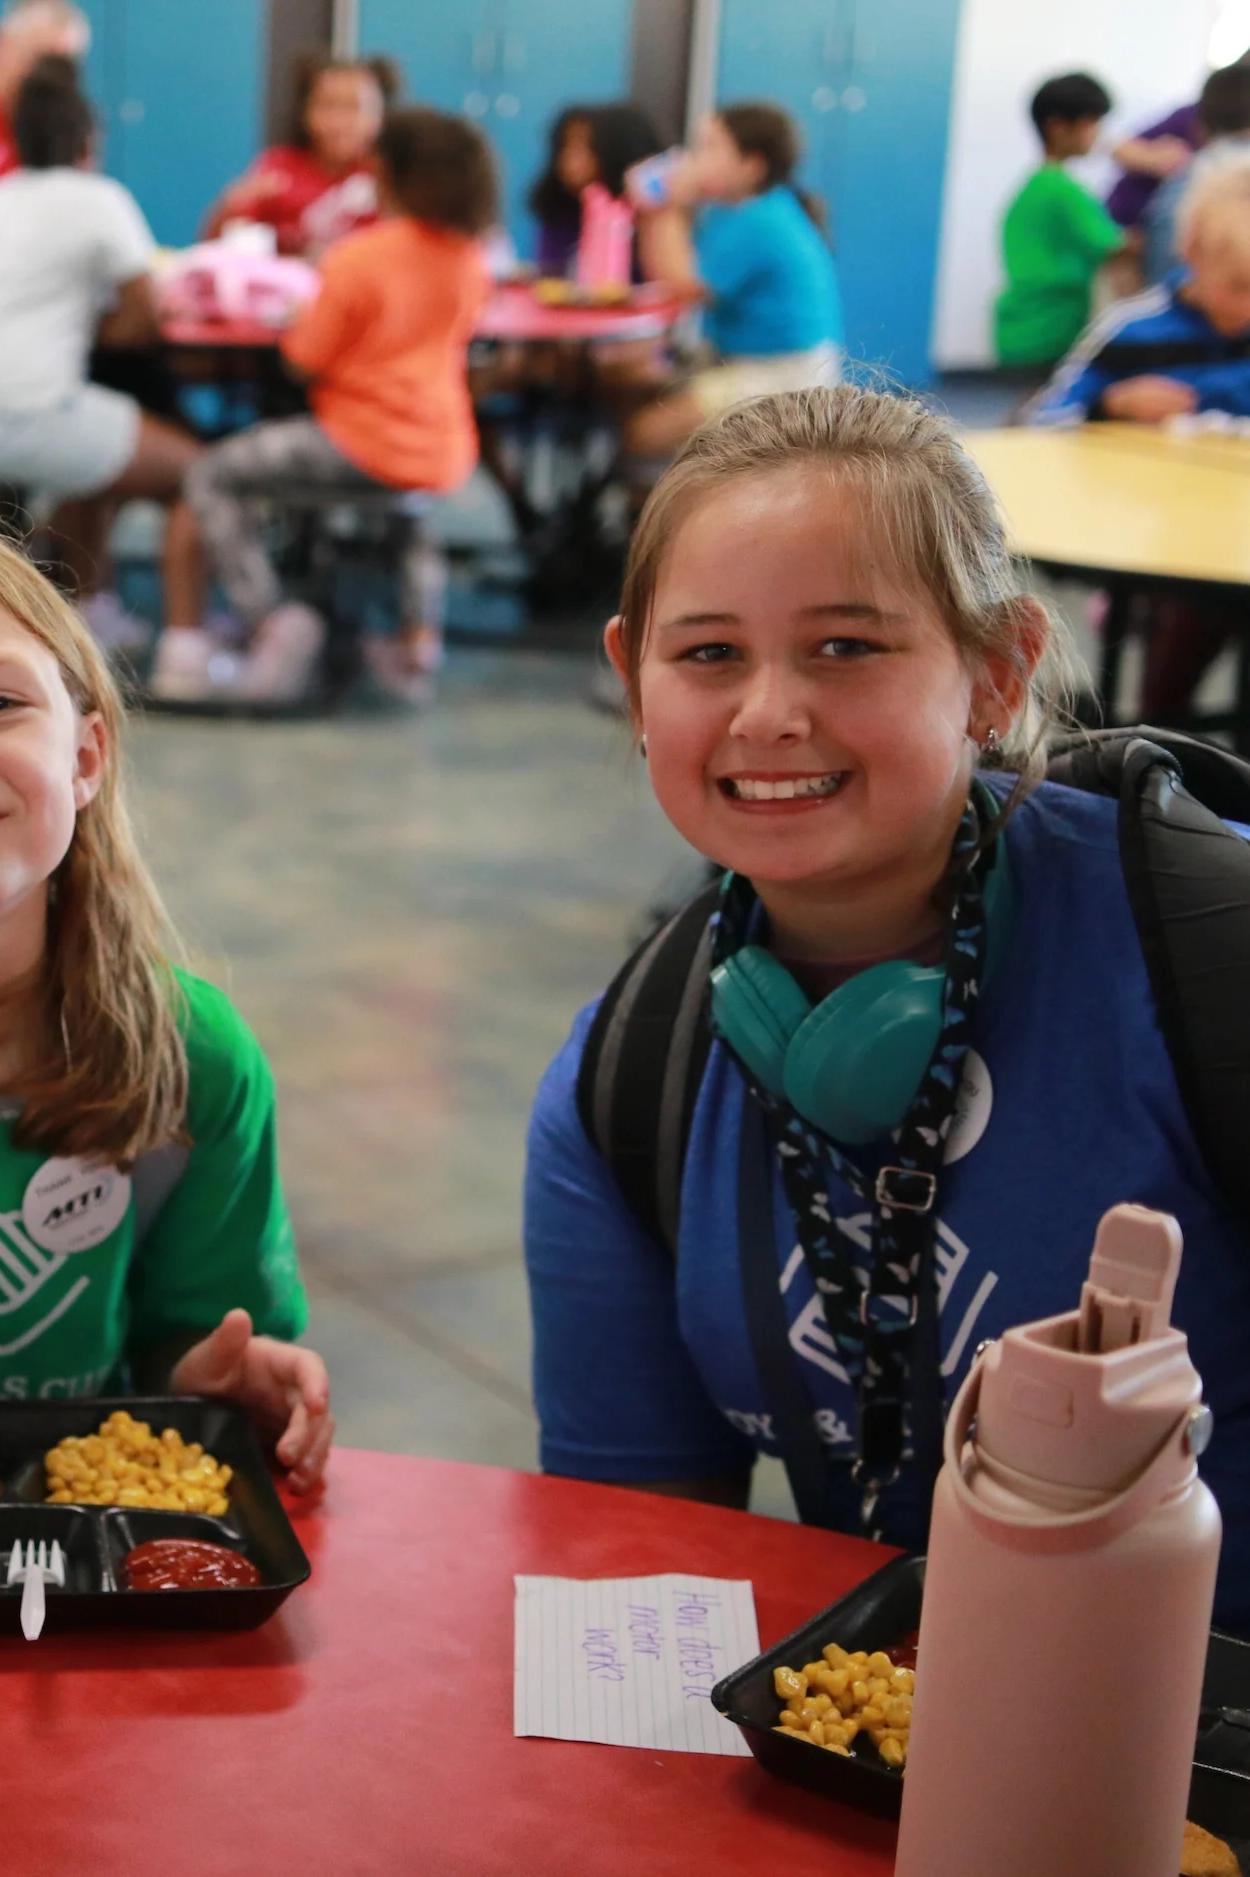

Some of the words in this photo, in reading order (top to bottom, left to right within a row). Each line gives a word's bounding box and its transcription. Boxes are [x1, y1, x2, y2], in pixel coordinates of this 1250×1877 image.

[814, 1408, 854, 1444] &
[672, 1590, 722, 1630] How
[627, 1604, 666, 1660] motor
[678, 1637, 723, 1681] does
[682, 1686, 712, 1699] a
